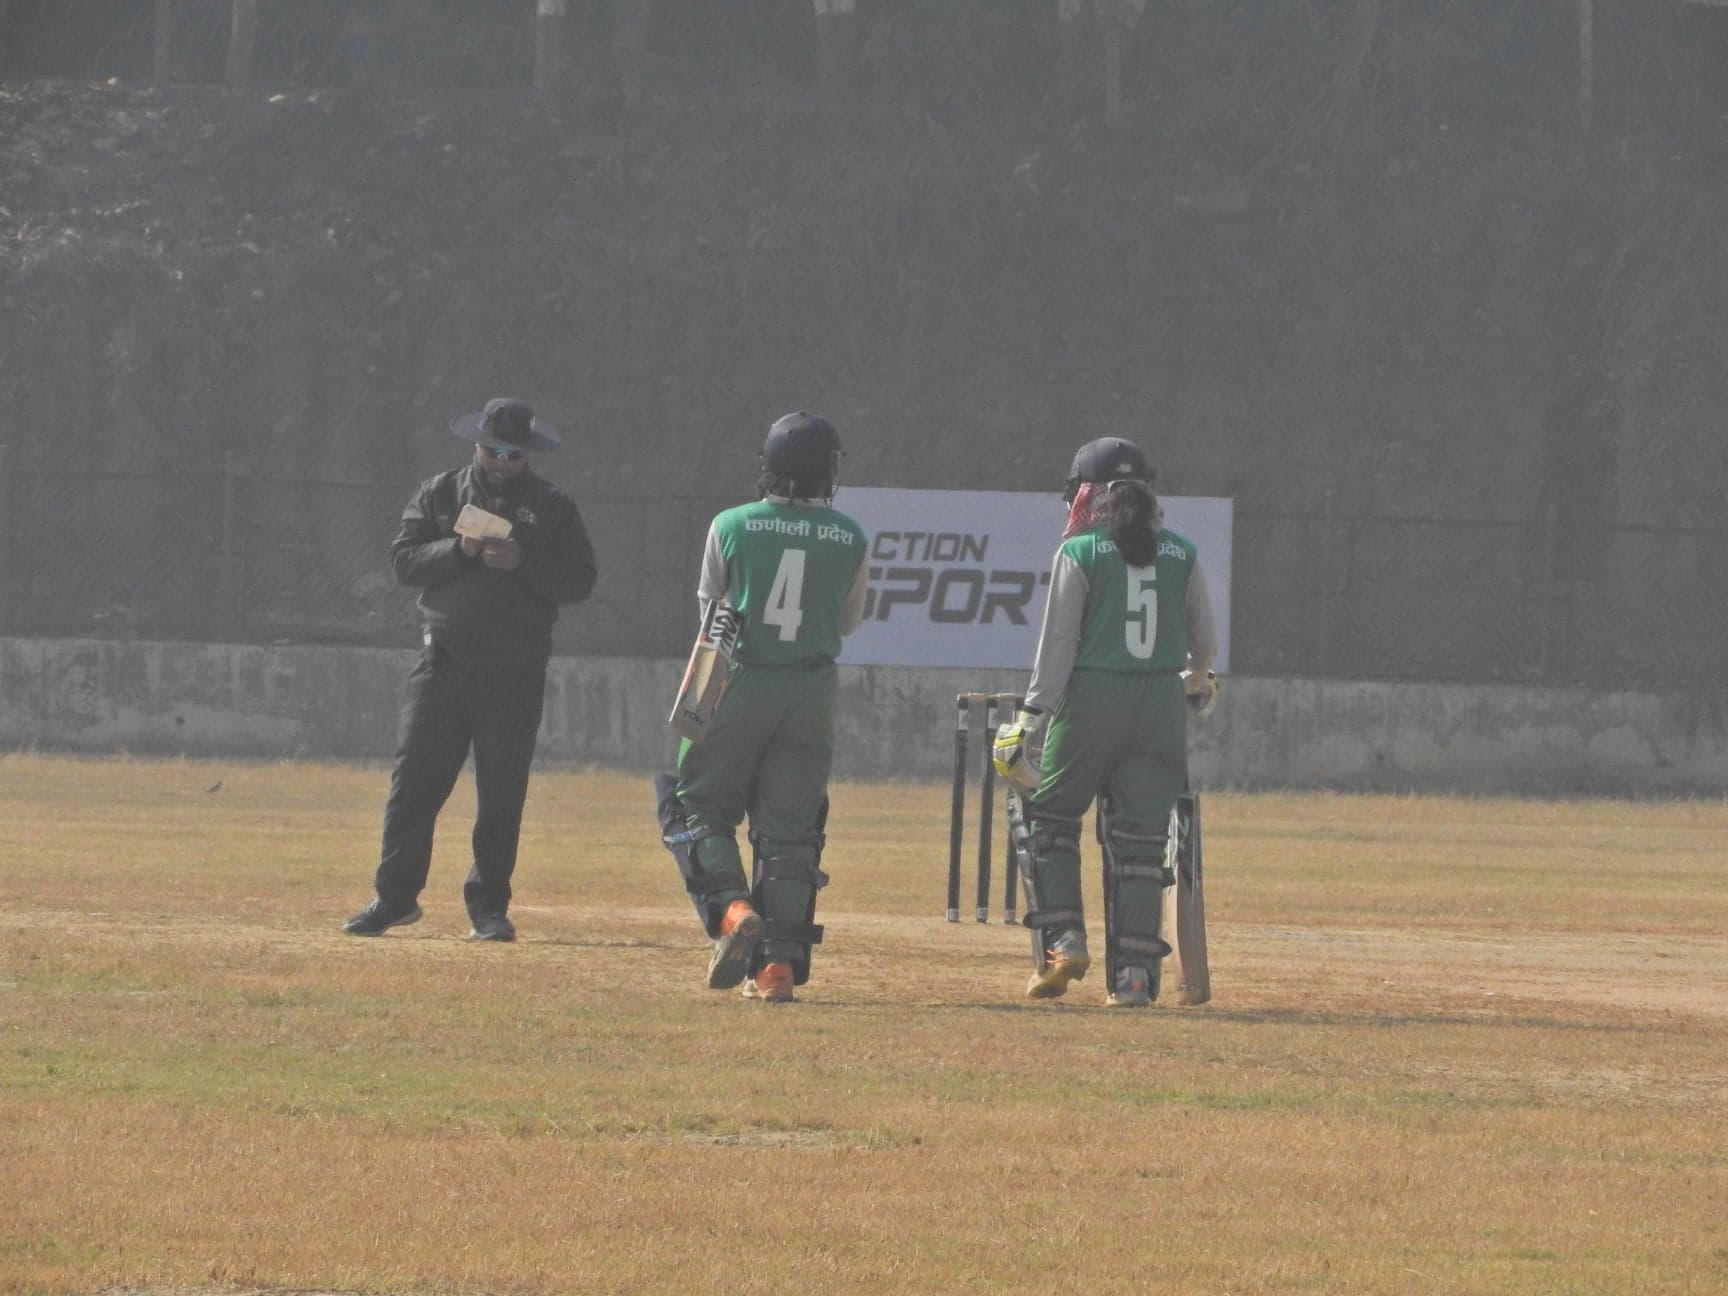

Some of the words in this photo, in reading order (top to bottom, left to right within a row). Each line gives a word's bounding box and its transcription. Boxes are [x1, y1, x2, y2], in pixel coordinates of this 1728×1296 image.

[816, 525, 854, 545] प्रदेश
[872, 532, 988, 561] CTION
[763, 549, 806, 642] 4
[863, 567, 1050, 625] POR
[1125, 564, 1158, 659] 5
